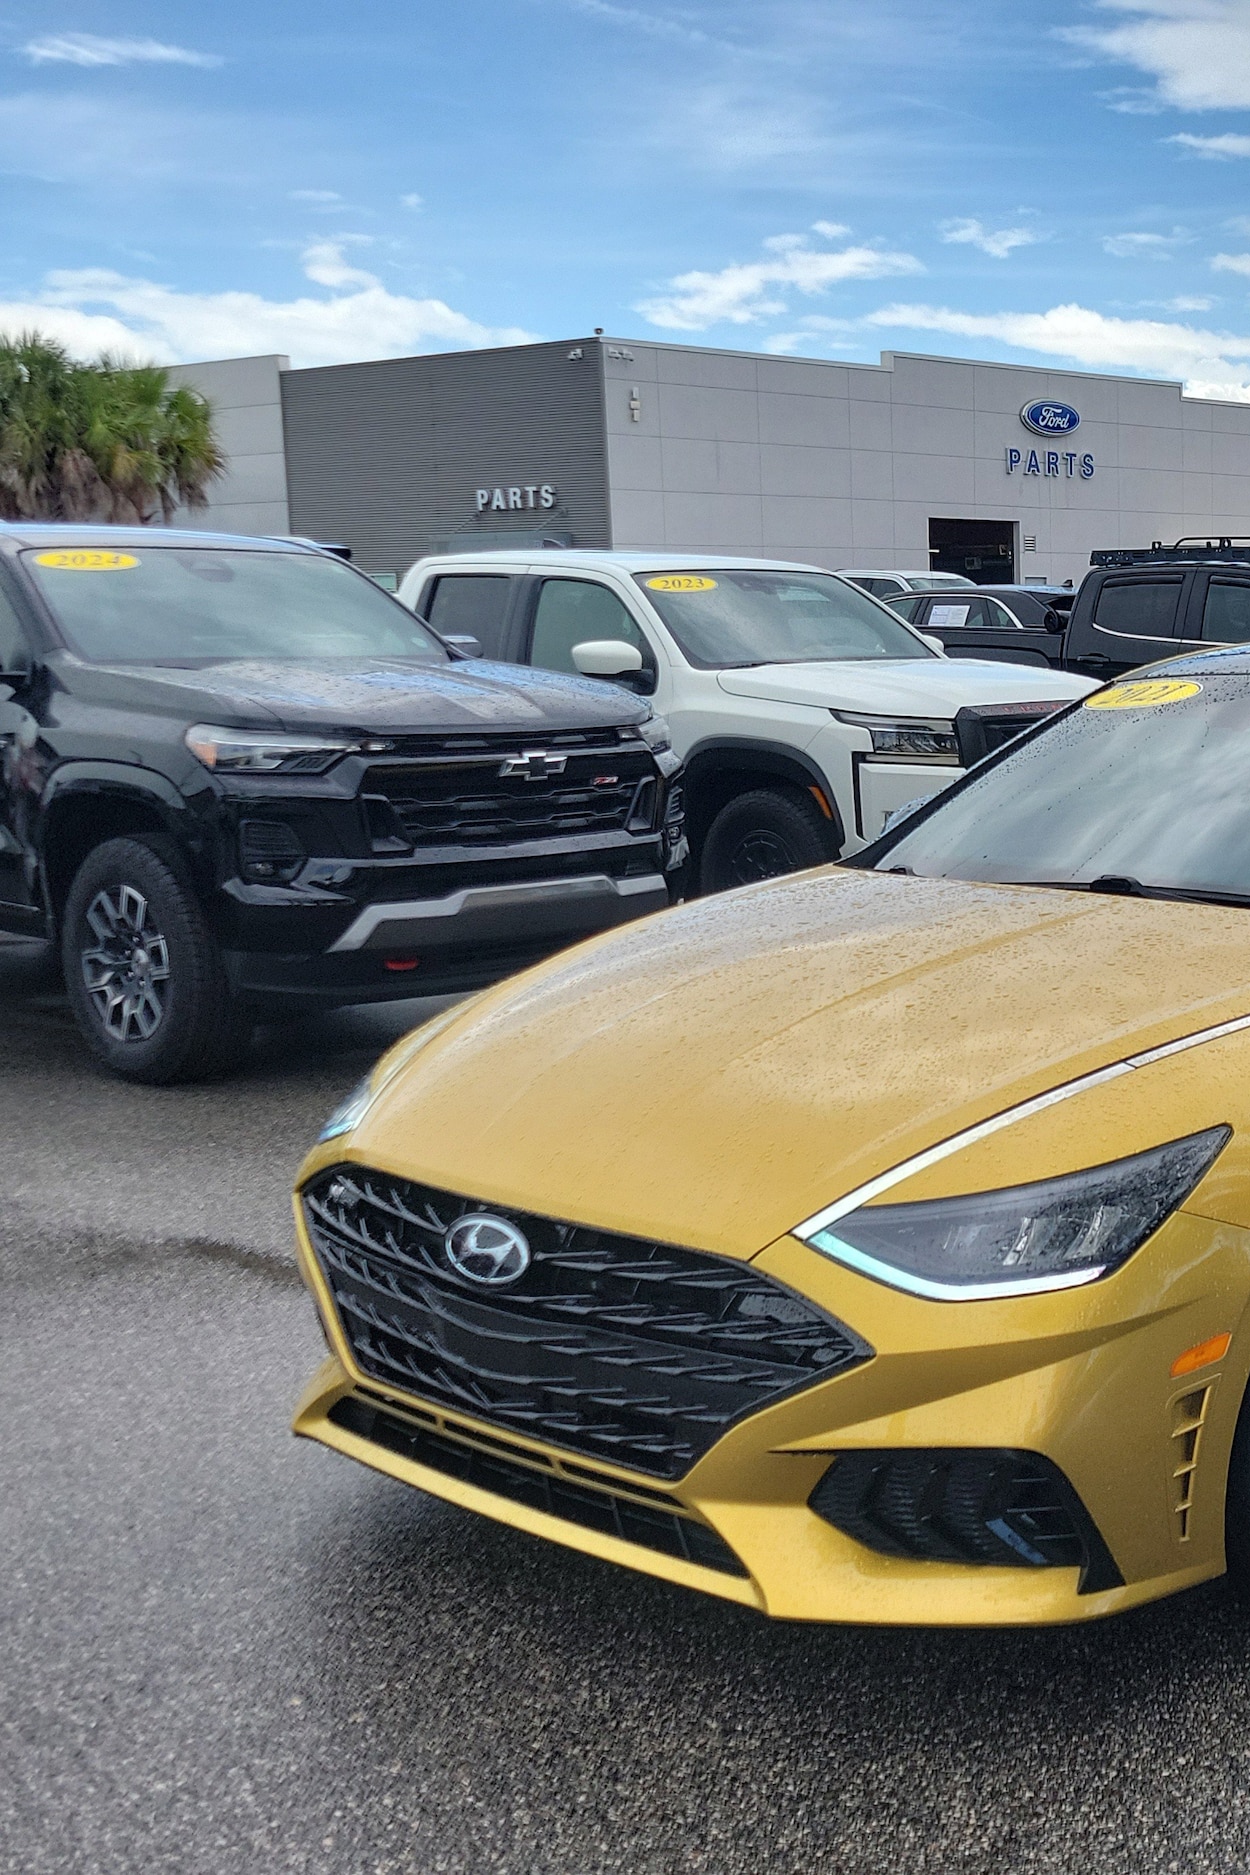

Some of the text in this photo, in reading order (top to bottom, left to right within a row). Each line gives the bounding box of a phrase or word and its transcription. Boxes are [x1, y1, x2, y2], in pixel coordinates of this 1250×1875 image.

[1038, 405, 1071, 430] Ford
[1006, 447, 1095, 479] PARTS
[477, 485, 554, 512] PARTS
[55, 554, 121, 566] 2024
[660, 578, 705, 590] 2023
